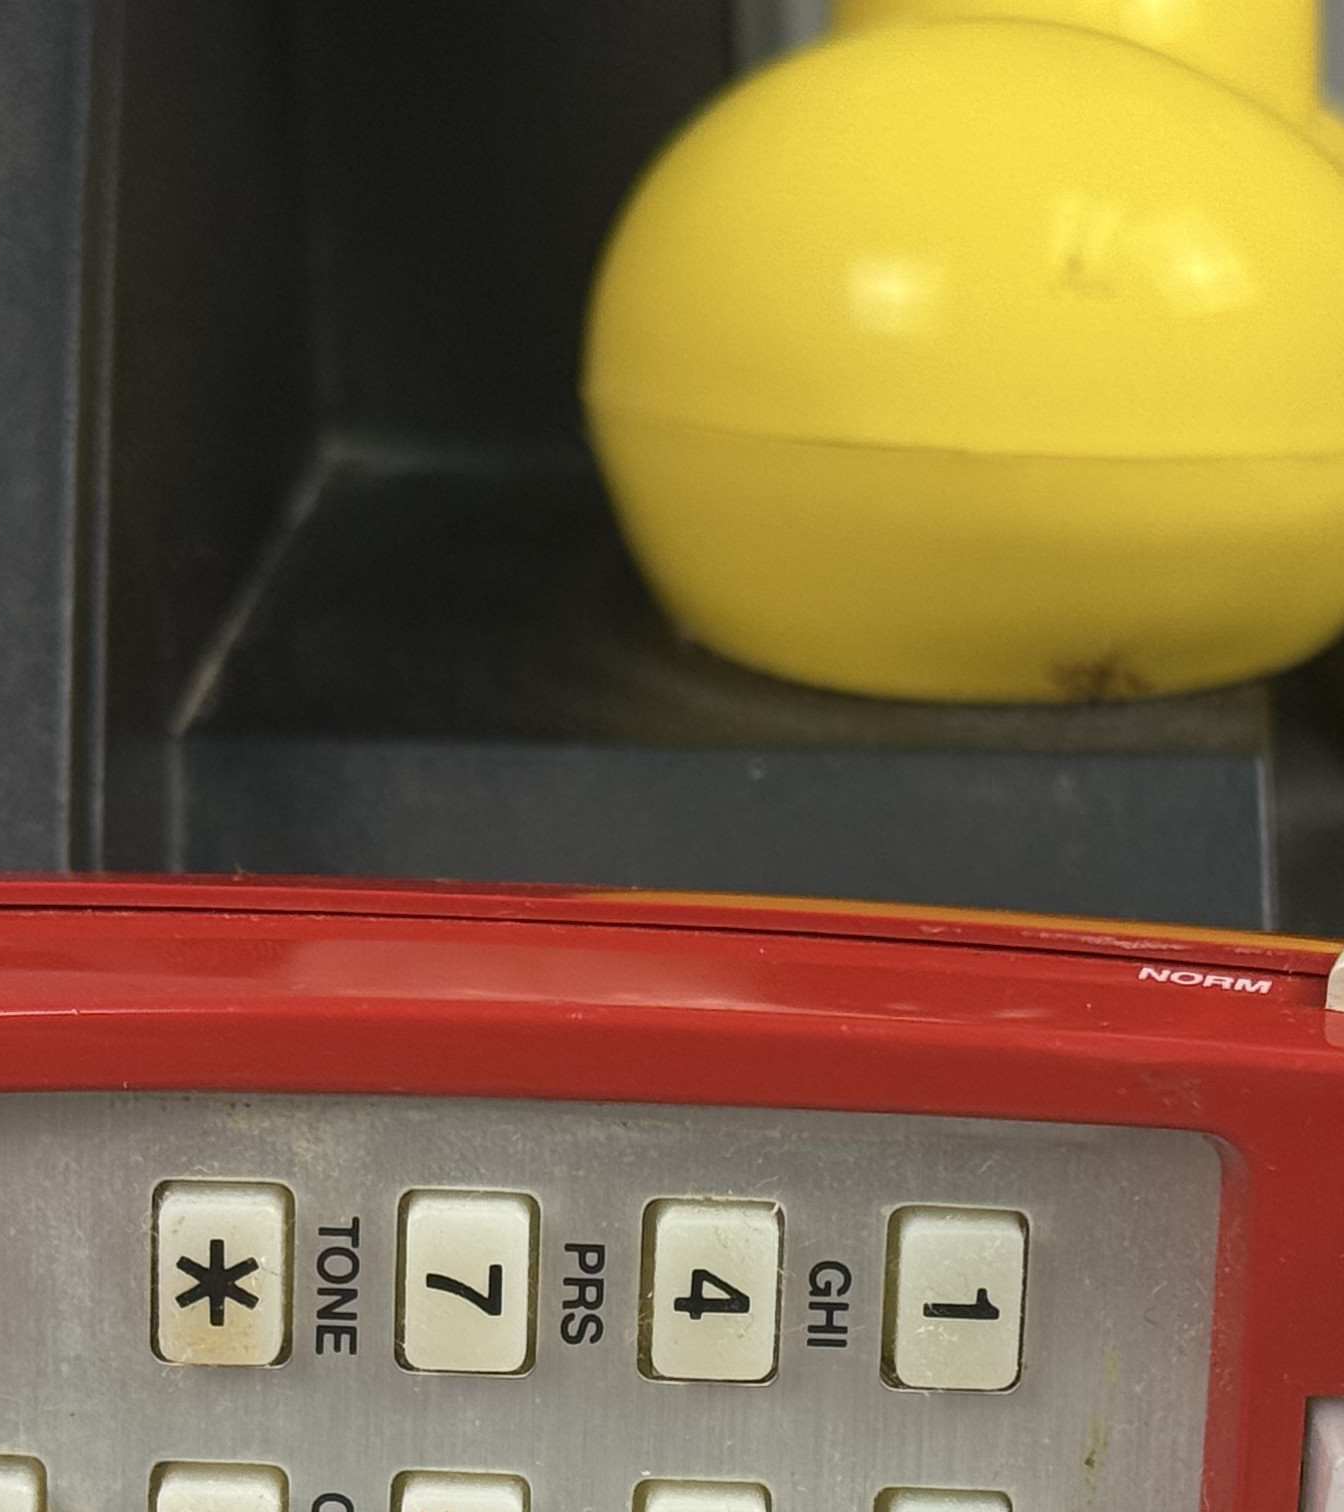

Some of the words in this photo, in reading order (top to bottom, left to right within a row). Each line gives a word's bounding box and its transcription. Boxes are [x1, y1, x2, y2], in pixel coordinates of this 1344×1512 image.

[1137, 967, 1273, 996] NORM
[314, 1216, 360, 1356] TONE
[425, 1264, 503, 1317] 7
[558, 1241, 606, 1346] PRS
[673, 1269, 751, 1320] 4
[805, 1260, 853, 1350] GHI
[922, 1288, 1000, 1322] 1
